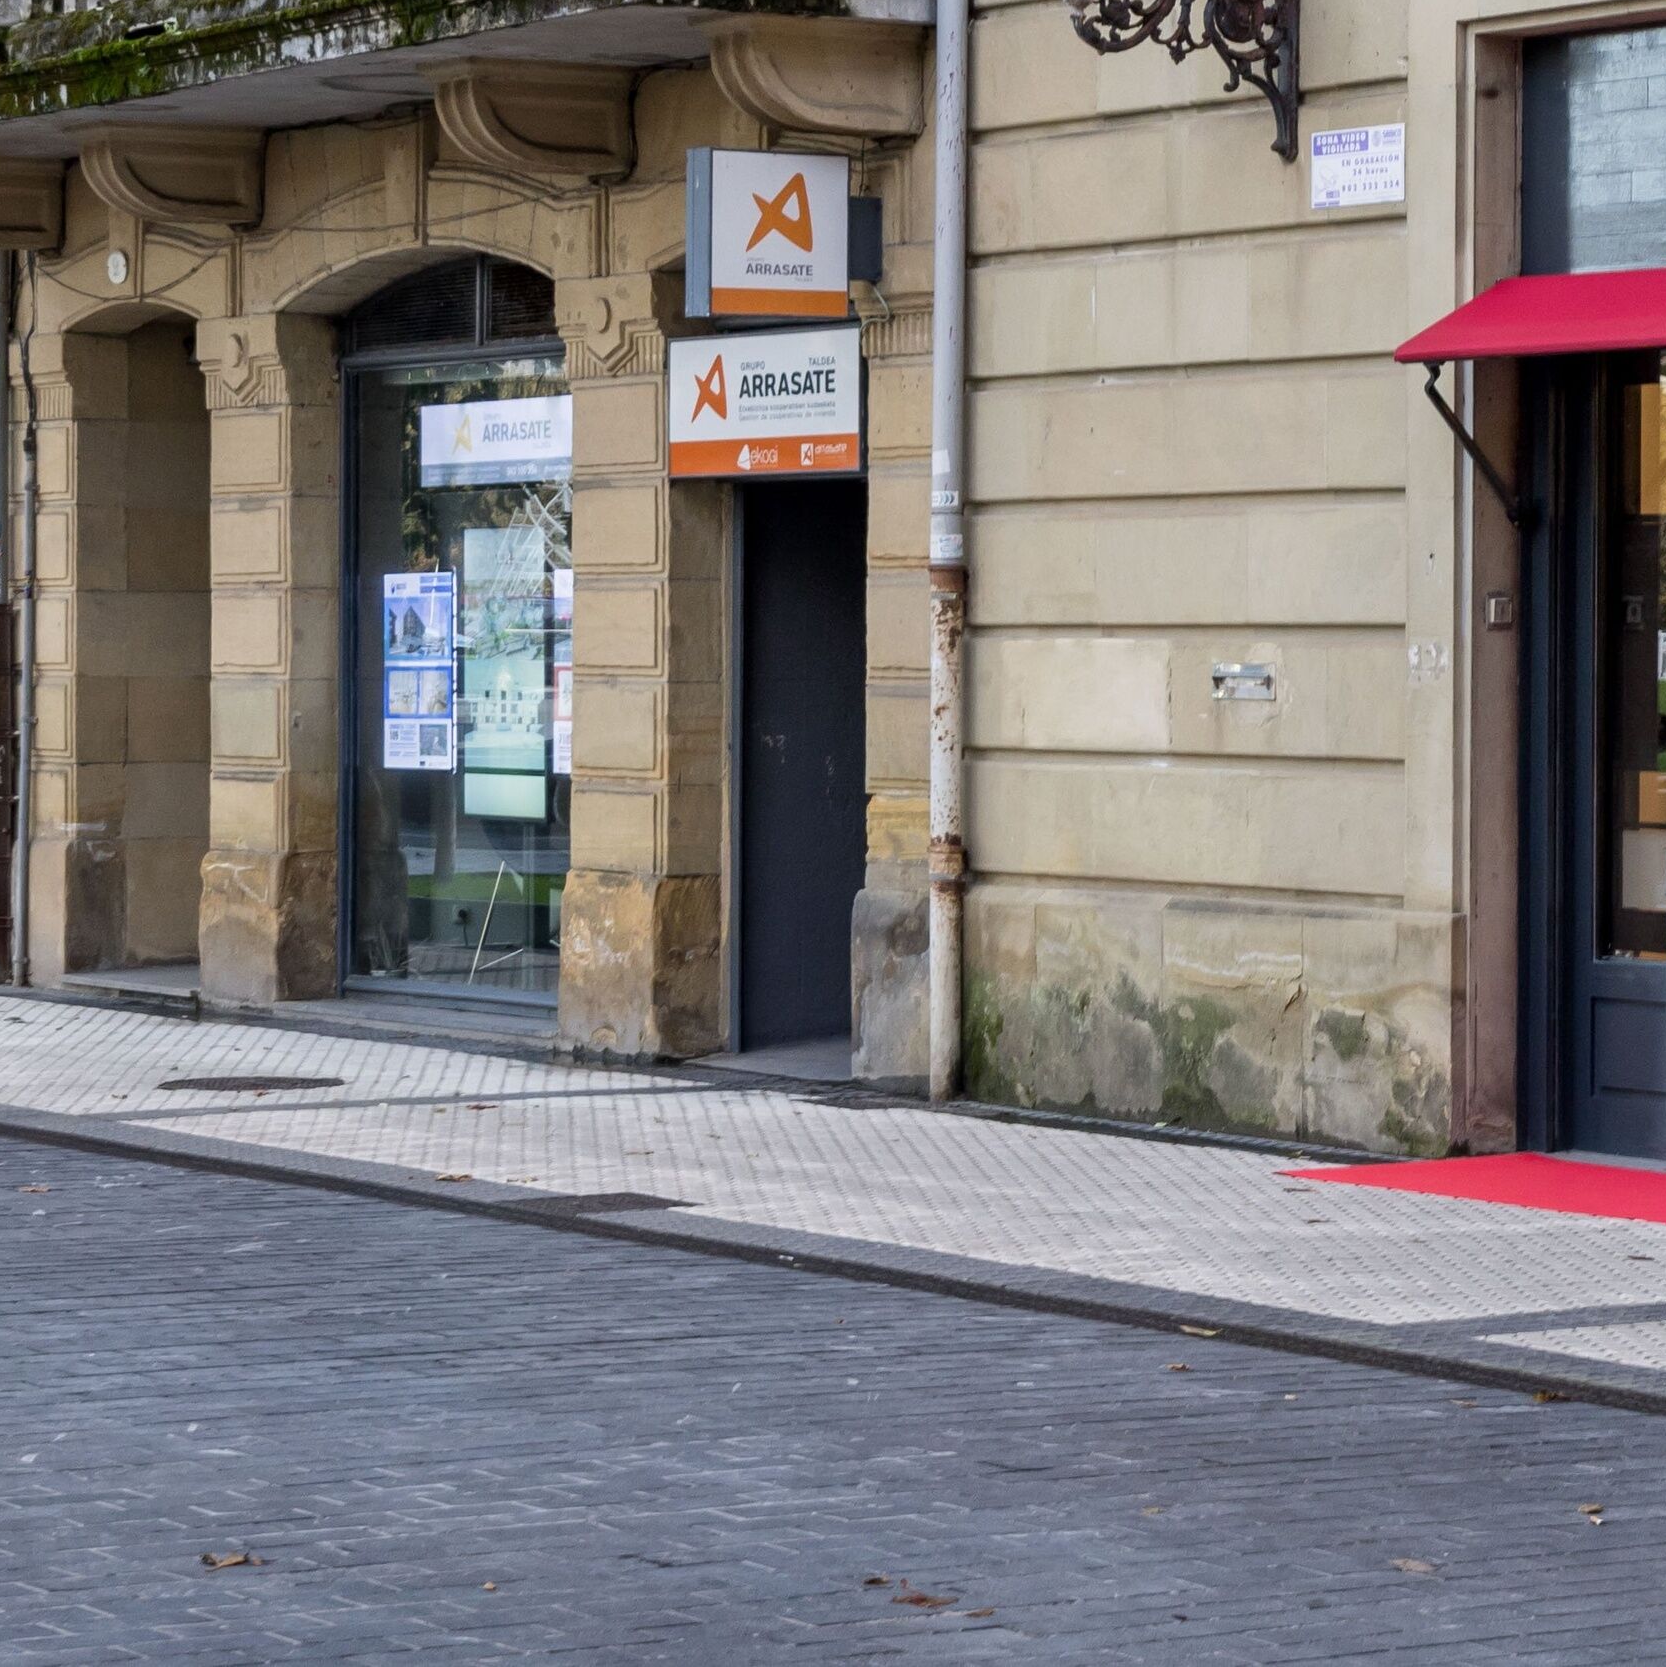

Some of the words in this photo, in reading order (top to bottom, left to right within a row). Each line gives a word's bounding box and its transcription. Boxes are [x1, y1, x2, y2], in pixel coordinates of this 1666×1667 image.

[746, 263, 813, 276] ARRASATE
[739, 369, 835, 399] ARRASATE
[482, 420, 551, 443] ARRASATE
